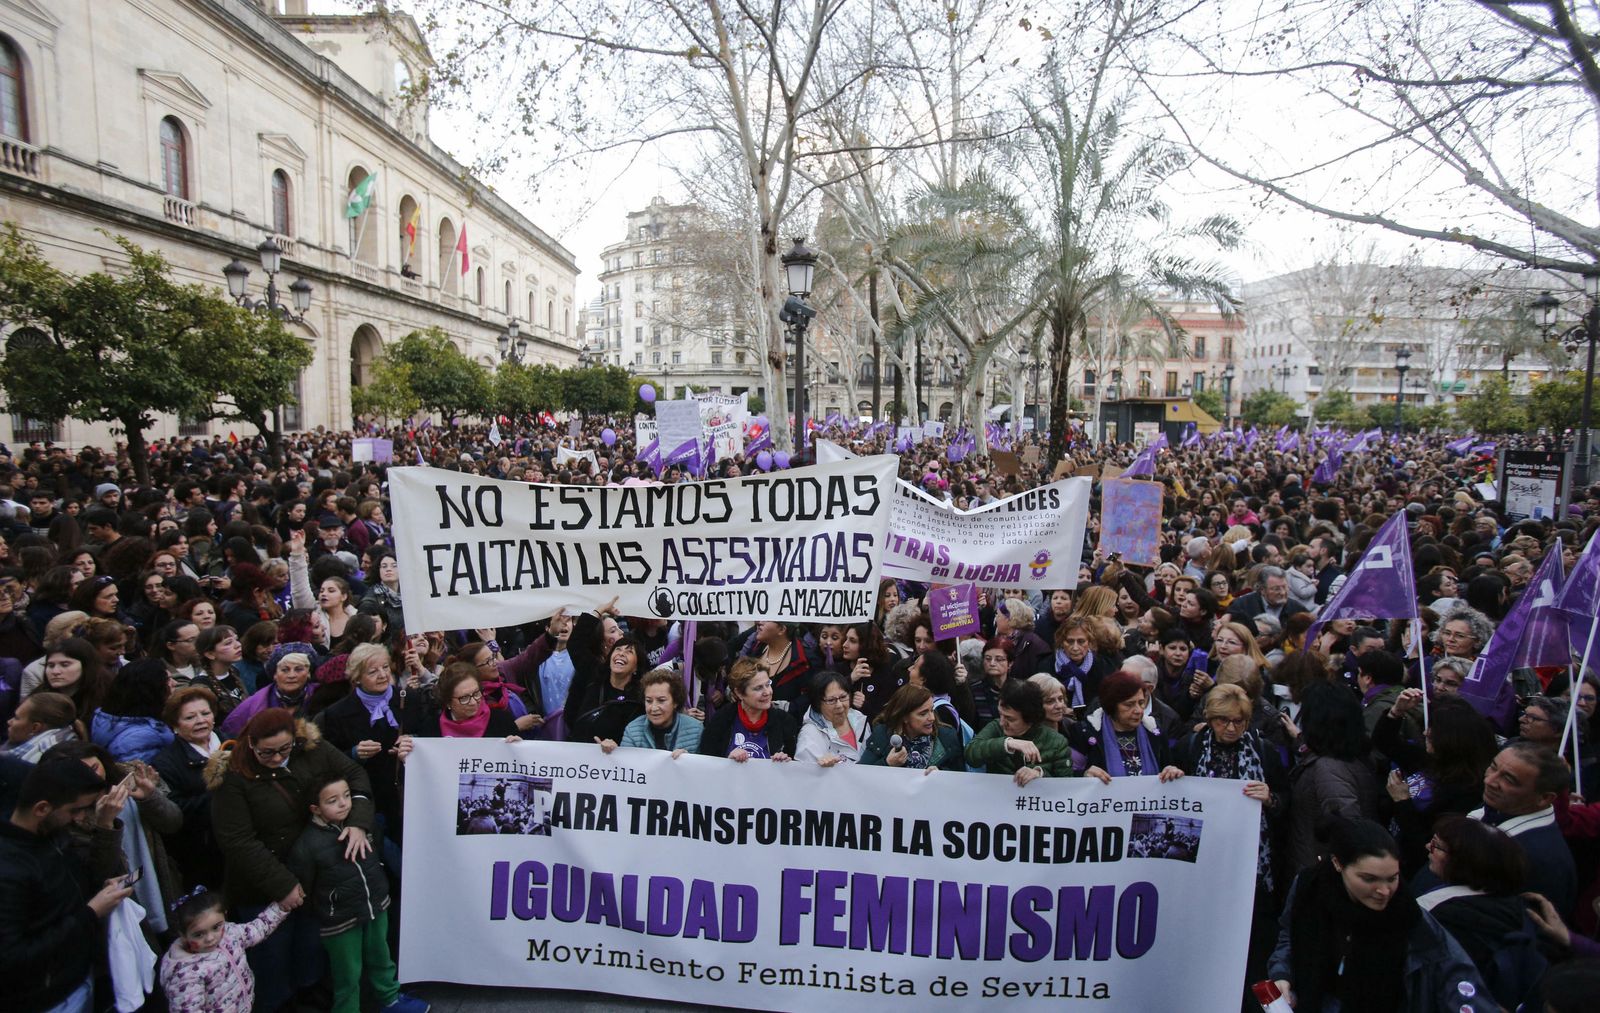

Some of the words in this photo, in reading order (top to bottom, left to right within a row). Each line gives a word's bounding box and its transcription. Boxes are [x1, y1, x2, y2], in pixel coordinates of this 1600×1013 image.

[638, 422, 658, 431] CONTR
[1506, 462, 1533, 470] Descubre
[1541, 464, 1561, 472] Sevilla
[435, 485, 504, 529] NO
[529, 481, 733, 530] ESTAMOS
[742, 475, 881, 522] TODAS
[915, 503, 930, 514] los
[934, 510, 965, 522] medios
[971, 515, 982, 523] de
[913, 511, 922, 520] la
[928, 514, 995, 530] instituciones
[912, 528, 926, 537] que
[931, 533, 957, 543] miran
[957, 529, 972, 537] los
[885, 532, 950, 566] TRAS
[423, 540, 569, 598] FALTAN
[574, 541, 652, 585] LAS
[658, 531, 874, 586] ASESINADAS
[931, 566, 950, 577] en
[953, 562, 1021, 582] LUCHA
[677, 590, 769, 616] COLECTIVO
[459, 758, 647, 785] #FeminismoSevilla
[1015, 796, 1203, 816] #HuelgaFeminista
[627, 797, 883, 852] TRANSFORMAR
[892, 817, 934, 857] LA
[943, 819, 1124, 864] SOCIEDAD
[490, 860, 759, 944] IGUALDAD
[779, 868, 1159, 963] FEMINISMO
[526, 939, 724, 982] Movimiento
[738, 962, 916, 996] Feminista
[929, 976, 968, 997] de
[982, 977, 1111, 1000] Sevilla
